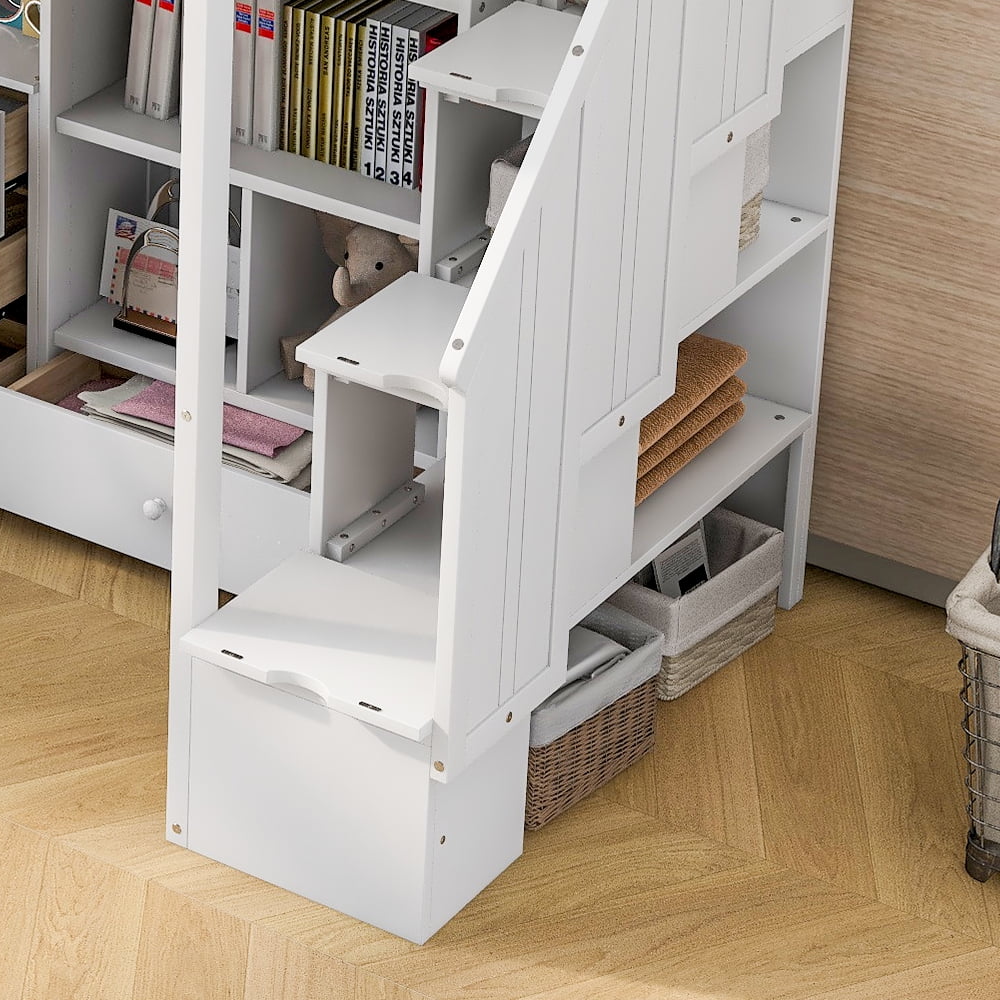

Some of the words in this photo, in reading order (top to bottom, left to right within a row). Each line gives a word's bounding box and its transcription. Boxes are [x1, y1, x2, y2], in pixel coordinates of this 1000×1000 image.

[366, 24, 378, 93] HISTORIA
[378, 27, 390, 95] HISTORIA
[393, 37, 405, 106] HISTORIA
[406, 37, 418, 106] HISRIA
[364, 97, 375, 150] SZTUKI
[376, 98, 387, 152] SZTUKI
[390, 110, 401, 163] SZTUKI
[404, 110, 415, 164] SZTUKI
[364, 162, 372, 176] 1
[376, 167, 385, 181] 2
[390, 171, 400, 185] 3
[402, 172, 413, 186] 4
